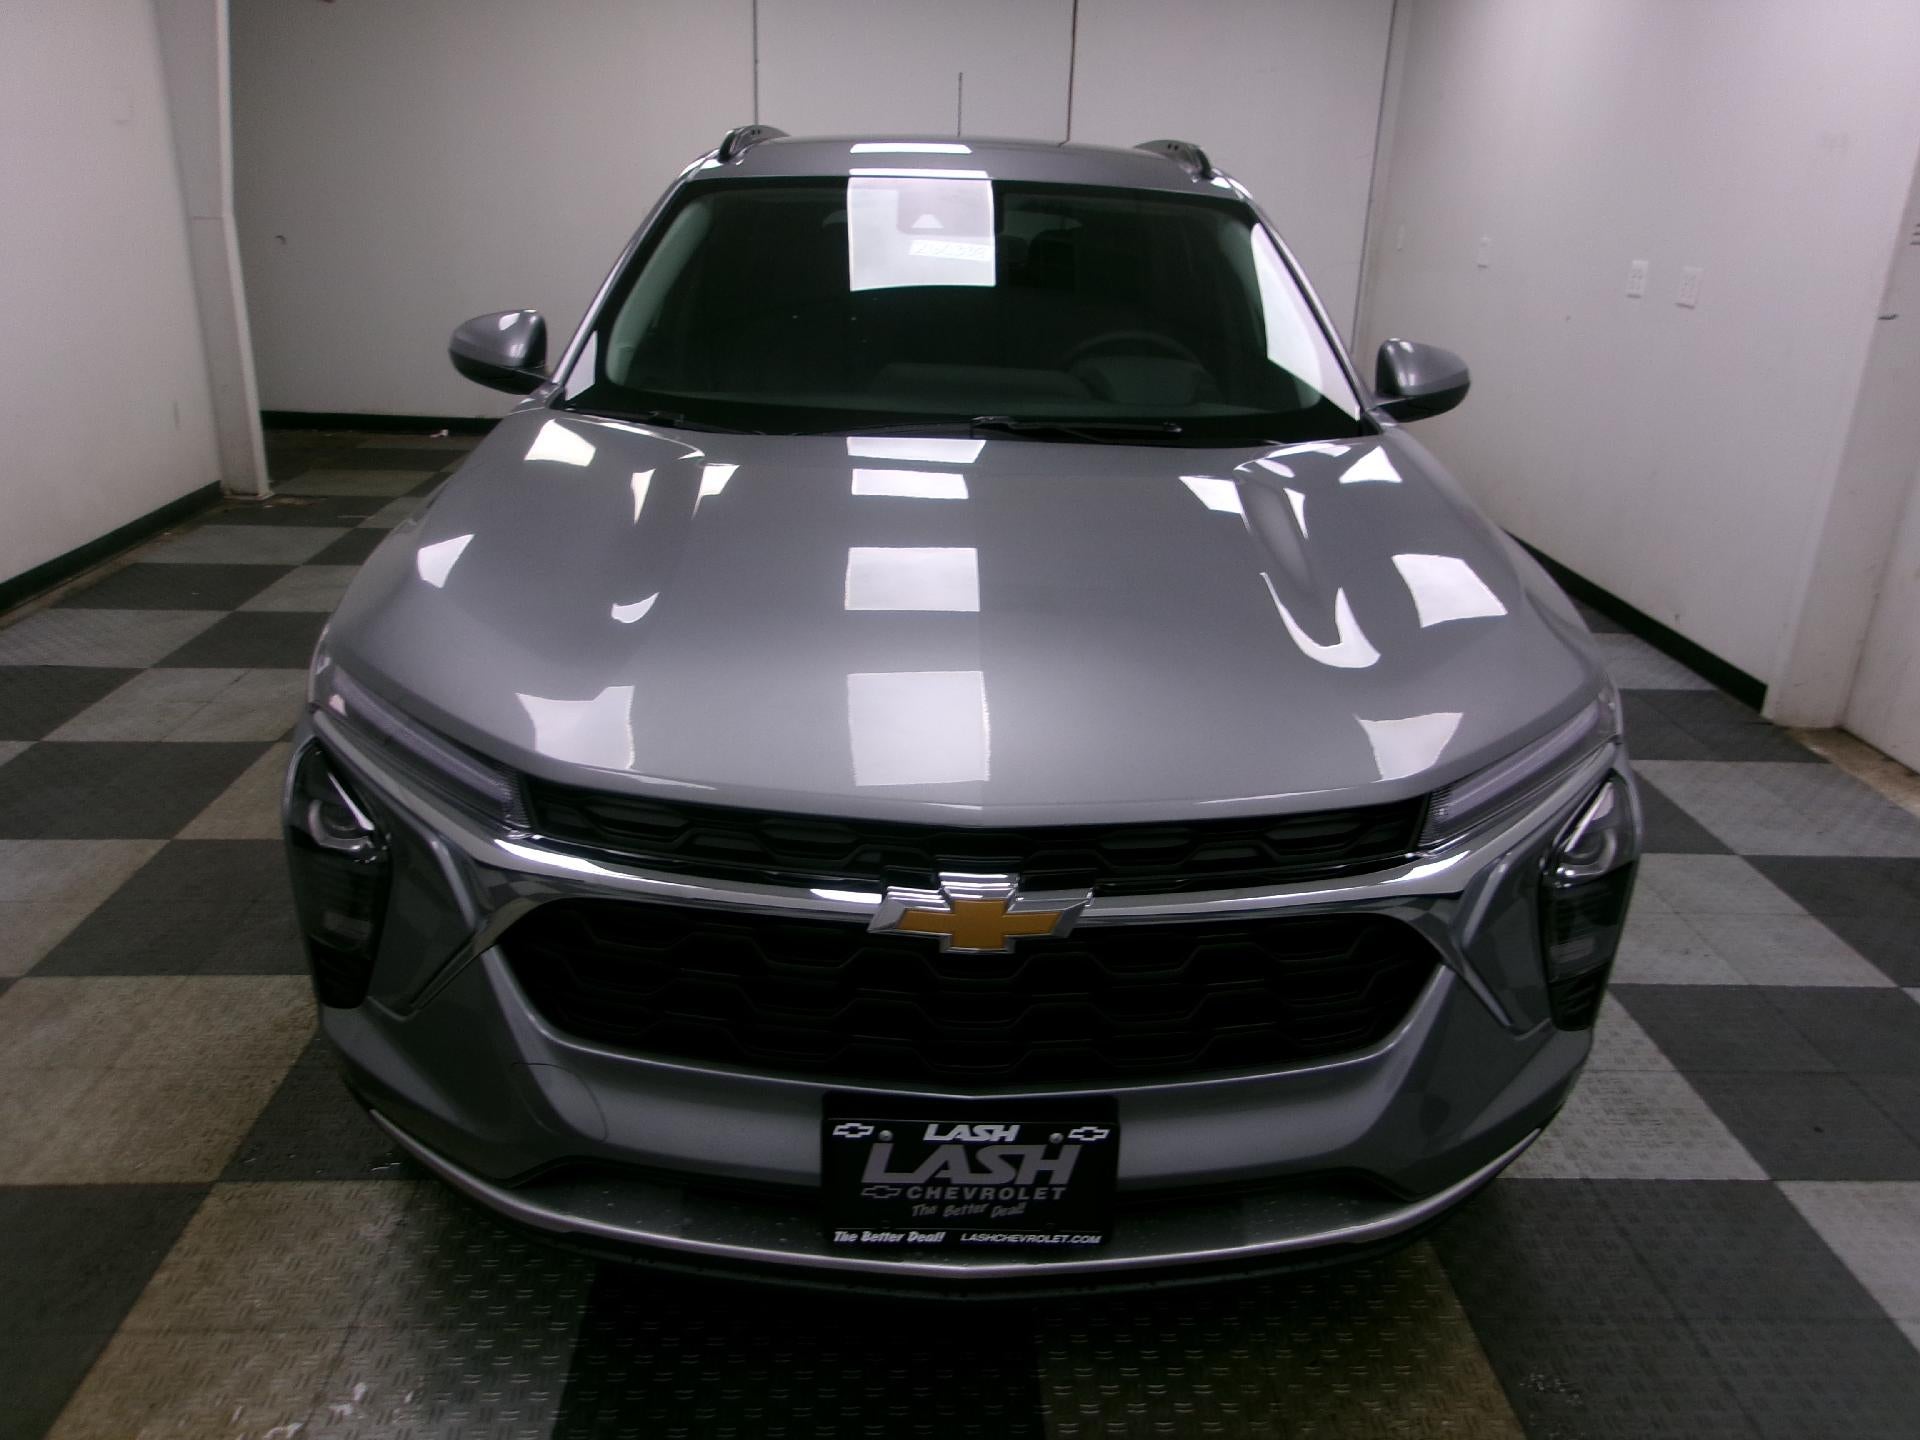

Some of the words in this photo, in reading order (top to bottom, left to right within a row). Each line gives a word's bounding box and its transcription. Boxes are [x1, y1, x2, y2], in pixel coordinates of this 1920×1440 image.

[924, 1124, 1019, 1141] LASH
[861, 1143, 1082, 1184] LASH
[906, 1186, 1066, 1200] CHEVROLET
[911, 1205, 936, 1217] The
[942, 1203, 988, 1217] Better
[833, 1231, 857, 1242] The
[860, 1231, 903, 1242] Better
[906, 1231, 945, 1242] Deal!
[960, 1233, 1101, 1243] LASHCHEVROLET.COM
